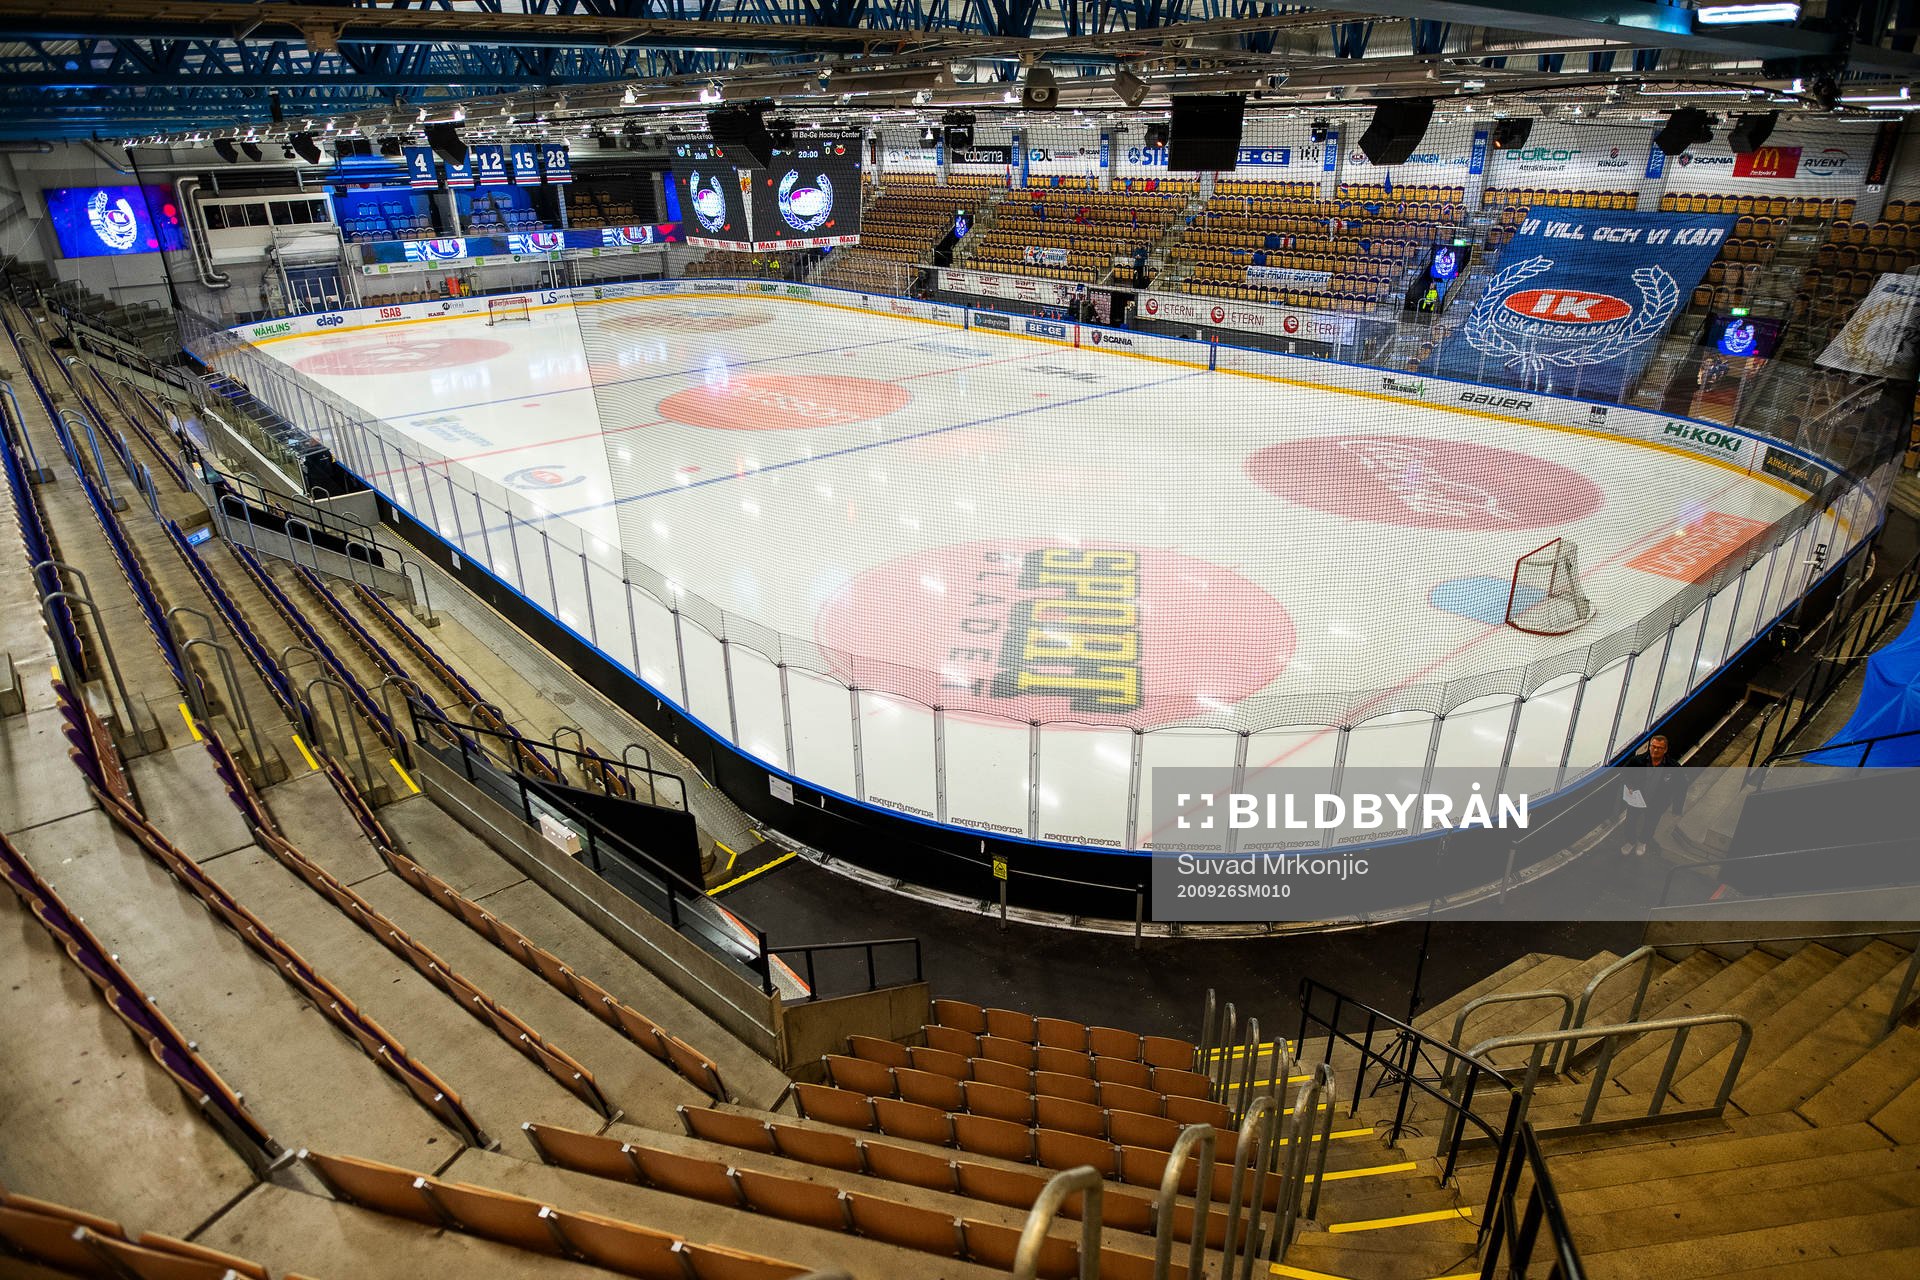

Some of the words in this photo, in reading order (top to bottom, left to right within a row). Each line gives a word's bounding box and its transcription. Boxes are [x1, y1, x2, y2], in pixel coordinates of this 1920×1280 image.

[819, 132, 841, 140] Hockey
[415, 153, 427, 172] 4
[480, 152, 502, 170] 12
[515, 152, 534, 169] 15
[547, 150, 566, 167] 28
[965, 149, 1003, 162] colorama
[1142, 147, 1169, 166] STE
[1694, 157, 1734, 165] SCANIA
[1518, 218, 1541, 236] VI
[1544, 220, 1584, 240] VILL
[1592, 226, 1638, 243] OCH
[1647, 228, 1669, 246] VI
[1672, 228, 1725, 247] KAN
[541, 292, 558, 305] LS
[1531, 294, 1603, 319] IK
[316, 313, 344, 327] elajo
[380, 307, 402, 318] ISAB
[253, 322, 290, 337] WÅHLINS
[1029, 323, 1062, 336] BE-GE
[1498, 310, 1621, 338] OSKARSHAMN
[1103, 335, 1132, 346] SCANIA
[1664, 422, 1743, 452] HiKOKI
[1015, 546, 1142, 709] SPORT
